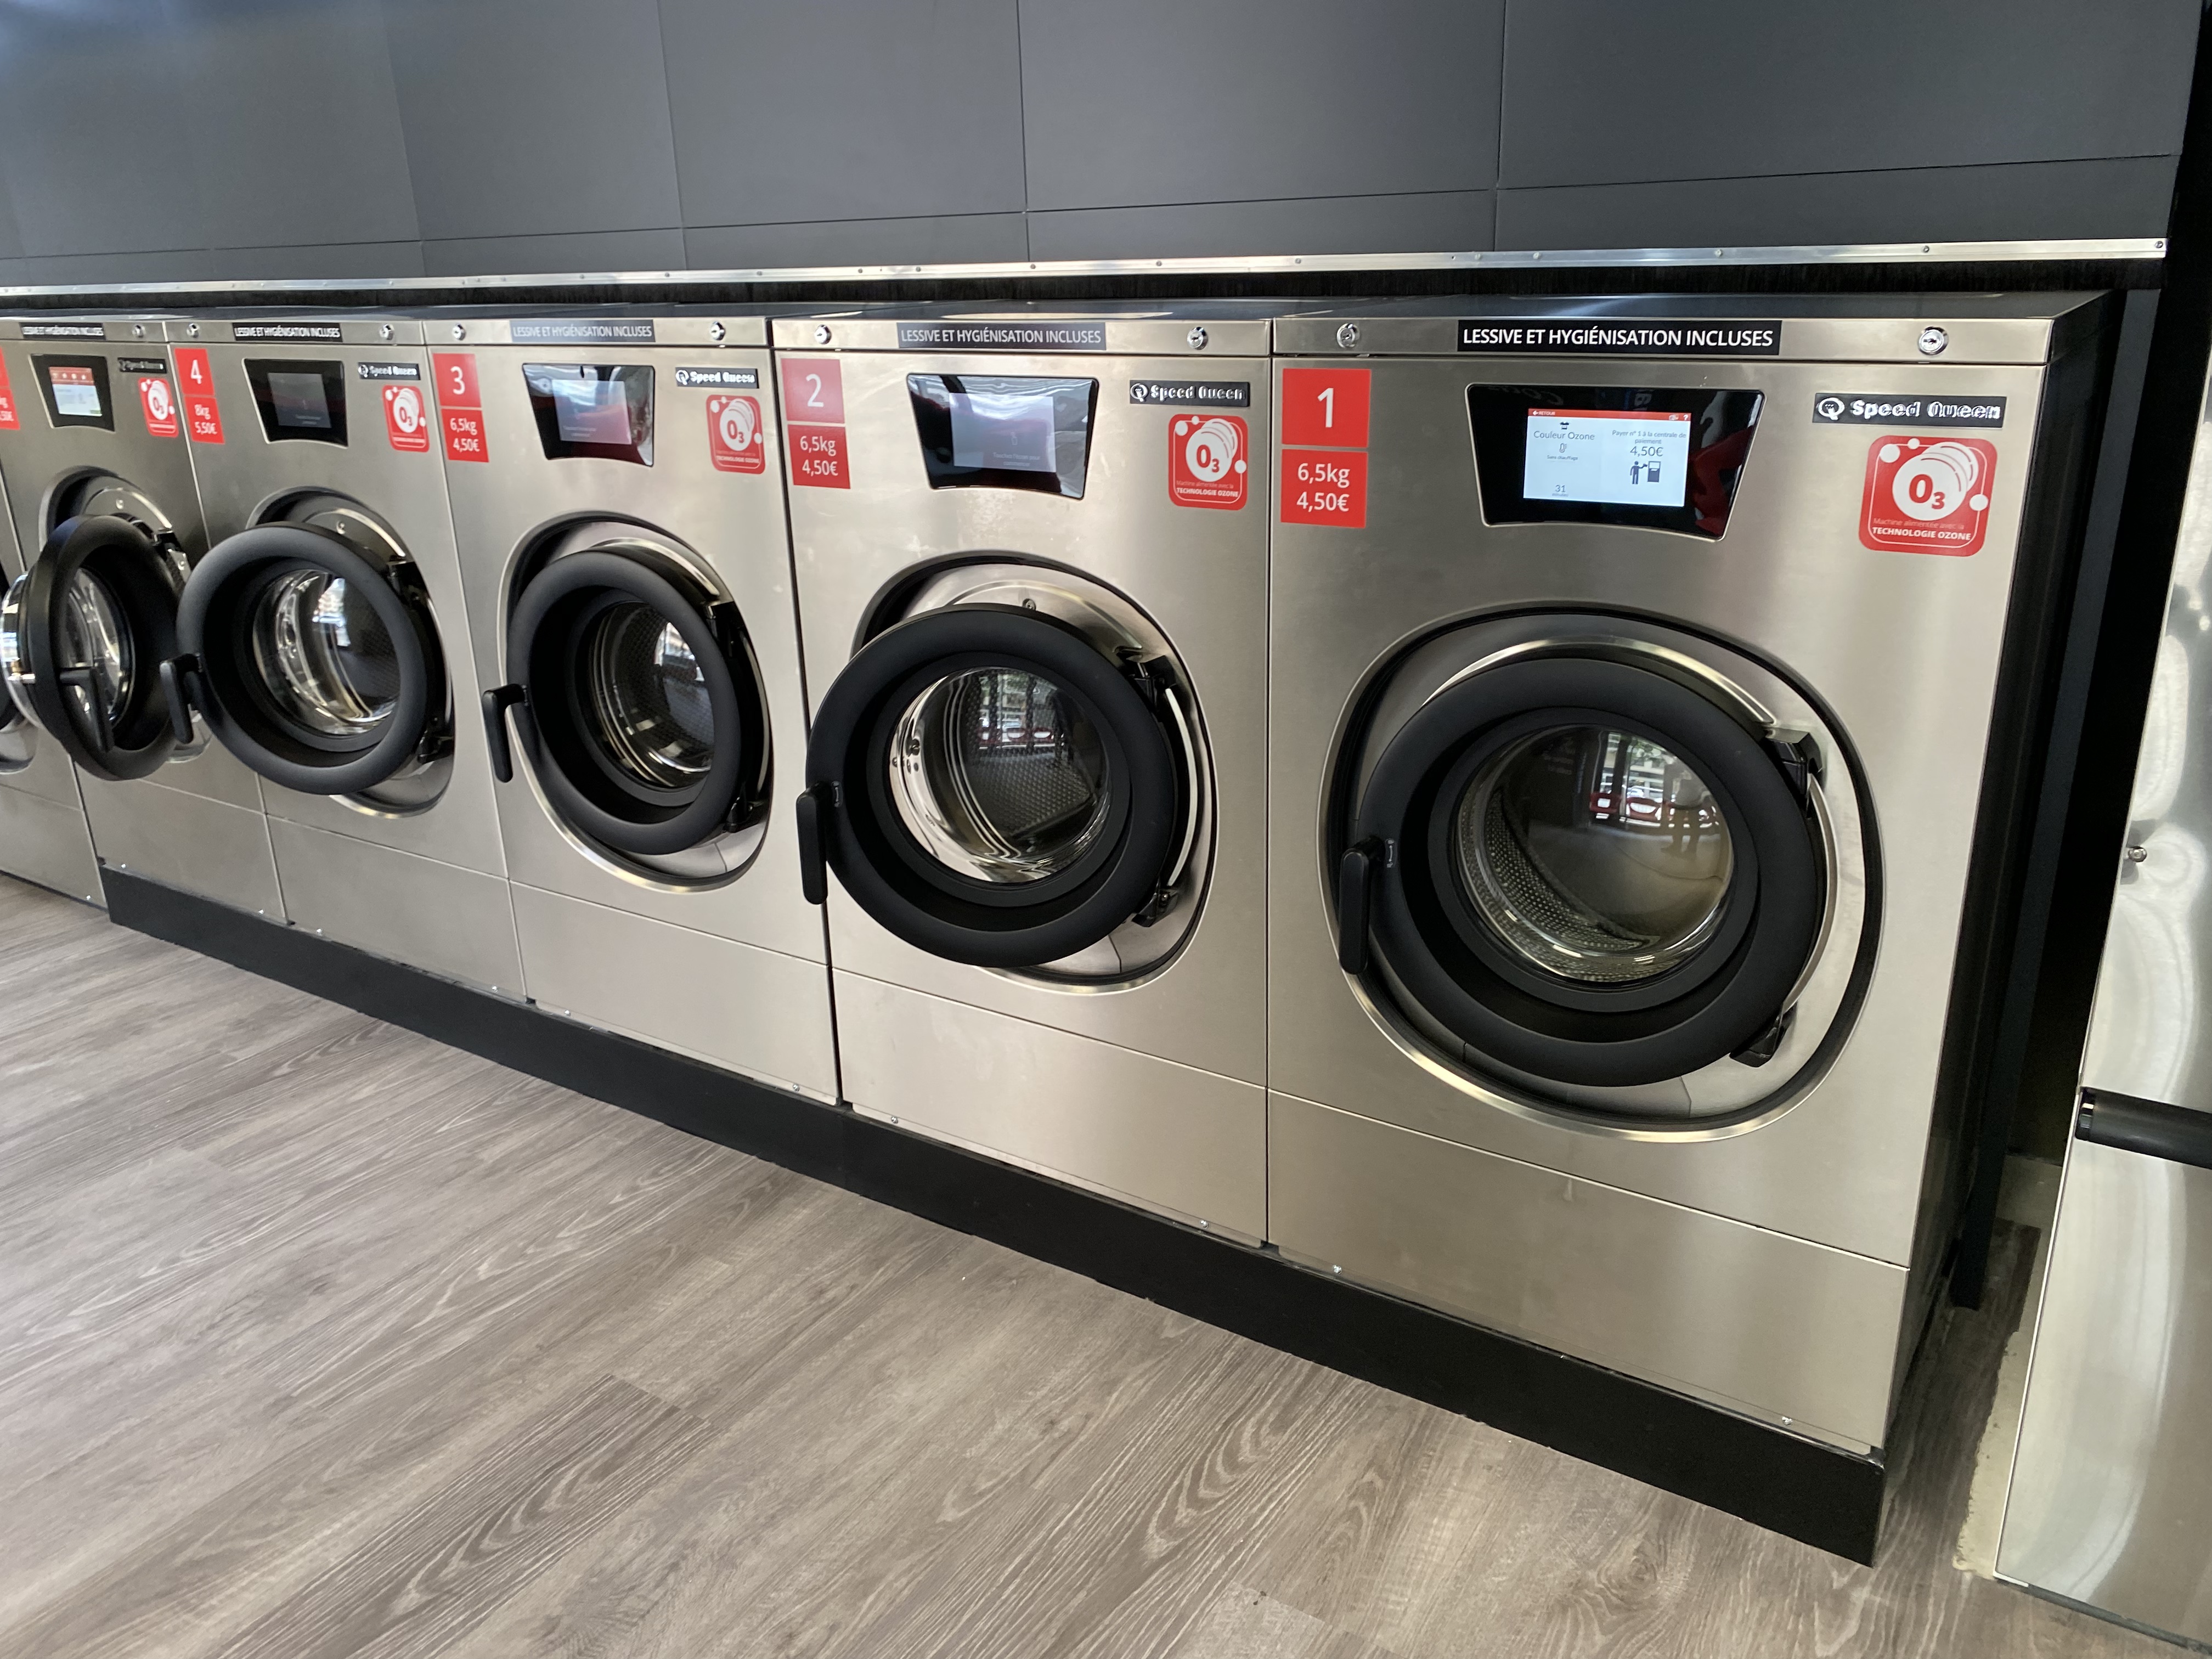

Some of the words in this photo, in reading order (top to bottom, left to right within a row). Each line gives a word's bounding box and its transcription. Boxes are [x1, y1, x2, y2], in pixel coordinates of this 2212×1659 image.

[513, 326, 541, 337] LESSIVE
[542, 326, 551, 337] ET
[613, 326, 652, 337] INCLUSES
[901, 329, 941, 342] LESSIVE
[943, 329, 955, 342] ET
[957, 326, 1043, 343] HYGIÉNISATION
[1045, 330, 1102, 344] INCLUSES
[1463, 329, 1522, 345] LESSIVE
[1526, 329, 1546, 345] ET
[1549, 325, 1681, 346] HYGIÉNISATION
[1686, 330, 1773, 347] INCLUSES
[190, 359, 202, 385] 4
[450, 366, 465, 395] 3
[690, 371, 721, 383] Speed
[805, 373, 824, 407] 2
[1150, 385, 1197, 401] Speed
[1198, 385, 1246, 400] Queen
[1317, 387, 1334, 428] 1
[1850, 399, 1921, 419] Speed
[1927, 401, 2001, 419] Queen
[450, 417, 478, 436] 6,5kg
[1533, 430, 1566, 439] Couleur
[1567, 432, 1595, 440] Ozone
[453, 437, 481, 453] 4,50€
[800, 436, 837, 456] 6,5kg
[1630, 445, 1664, 458] 4,50€
[802, 459, 838, 477] 4,50€
[1297, 462, 1351, 488] 6,5kg
[1176, 487, 1217, 496] TECHNOLOGIE
[1555, 484, 1566, 493] 31
[1296, 491, 1350, 512] 4,50€
[1904, 520, 1939, 528] alimentée
[1872, 527, 1936, 539] TECHNOLOGIE
[1937, 531, 1972, 540] OZONE
